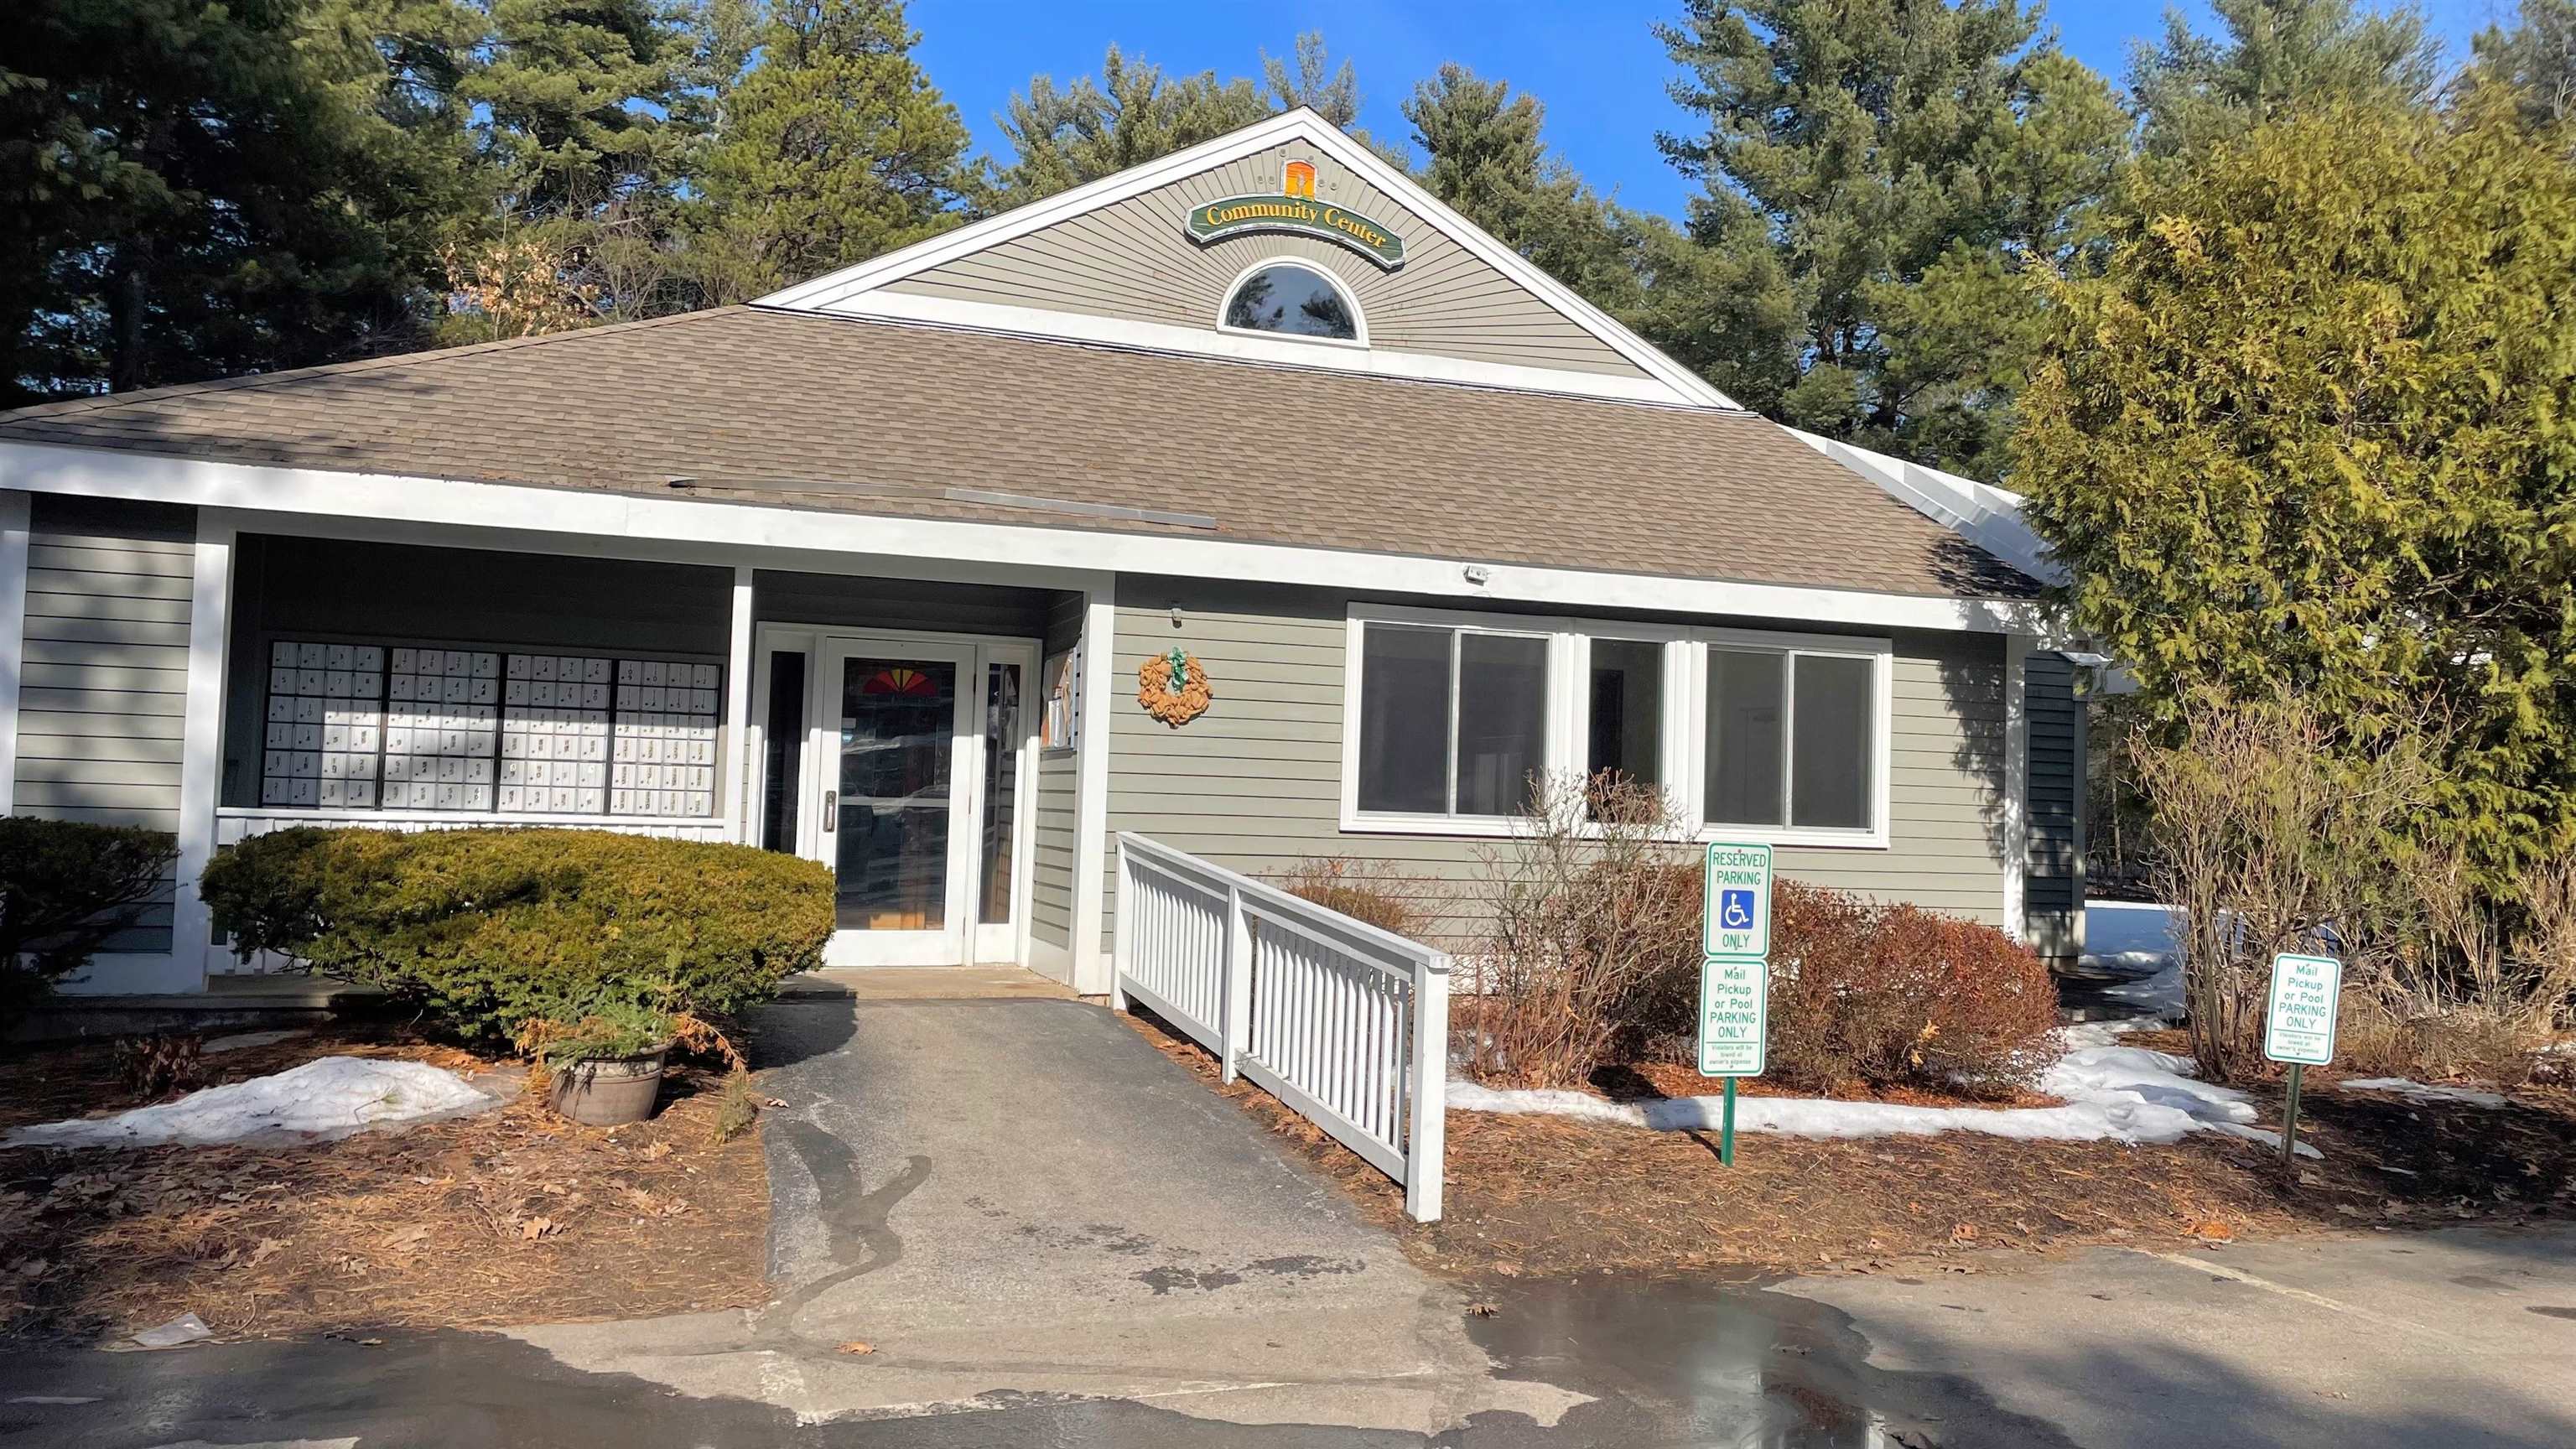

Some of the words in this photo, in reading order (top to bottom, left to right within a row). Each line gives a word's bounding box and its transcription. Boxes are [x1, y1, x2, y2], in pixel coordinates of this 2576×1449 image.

[1206, 200, 1318, 226] Community
[1324, 207, 1387, 249] Center
[1712, 851, 1767, 868] RESERVED
[1716, 870, 1761, 886] PARKING
[1722, 933, 1750, 948] ONLY
[1724, 969, 1746, 980] Mail
[2296, 964, 2318, 976] Mail
[1716, 983, 1752, 997] Pickup
[2288, 977, 2323, 992] Pickup
[1714, 1000, 1725, 1009] or
[1730, 998, 1753, 1009] Pool
[2284, 992, 2295, 1000] or
[2300, 991, 2324, 1004] Pool
[2278, 1001, 2327, 1017] PARKING
[1710, 1011, 1757, 1024] PARKING
[2286, 1015, 2317, 1030] ONLY
[1717, 1026, 1748, 1038] ONLY
